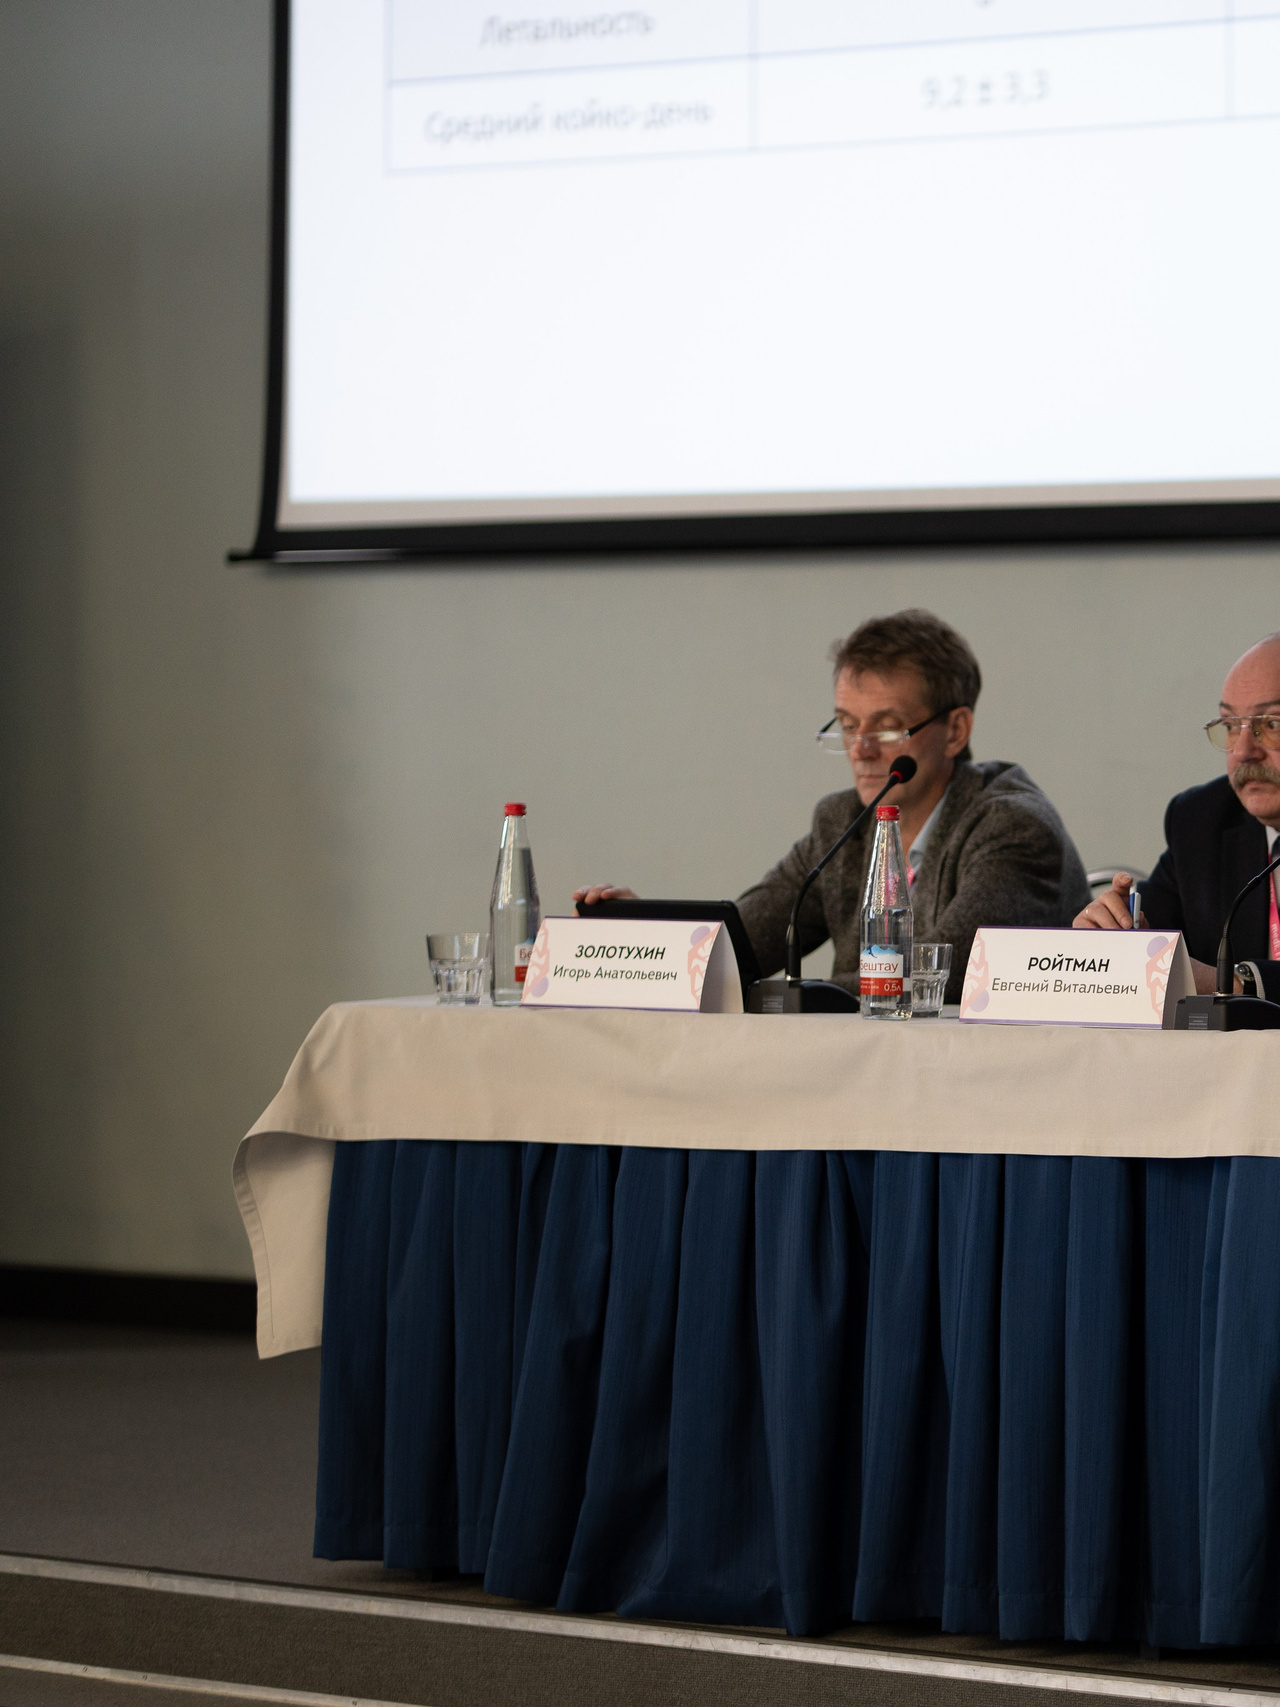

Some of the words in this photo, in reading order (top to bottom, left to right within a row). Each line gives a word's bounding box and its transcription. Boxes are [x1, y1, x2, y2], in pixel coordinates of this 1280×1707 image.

[575, 944, 666, 960] ЗОЛОТУХИН
[1027, 953, 1110, 972] РОЙТМАН
[553, 965, 591, 981] Игорь
[594, 966, 678, 981] Анатольевич
[991, 977, 1049, 993] Евгений
[1053, 979, 1138, 995] Витальевич
